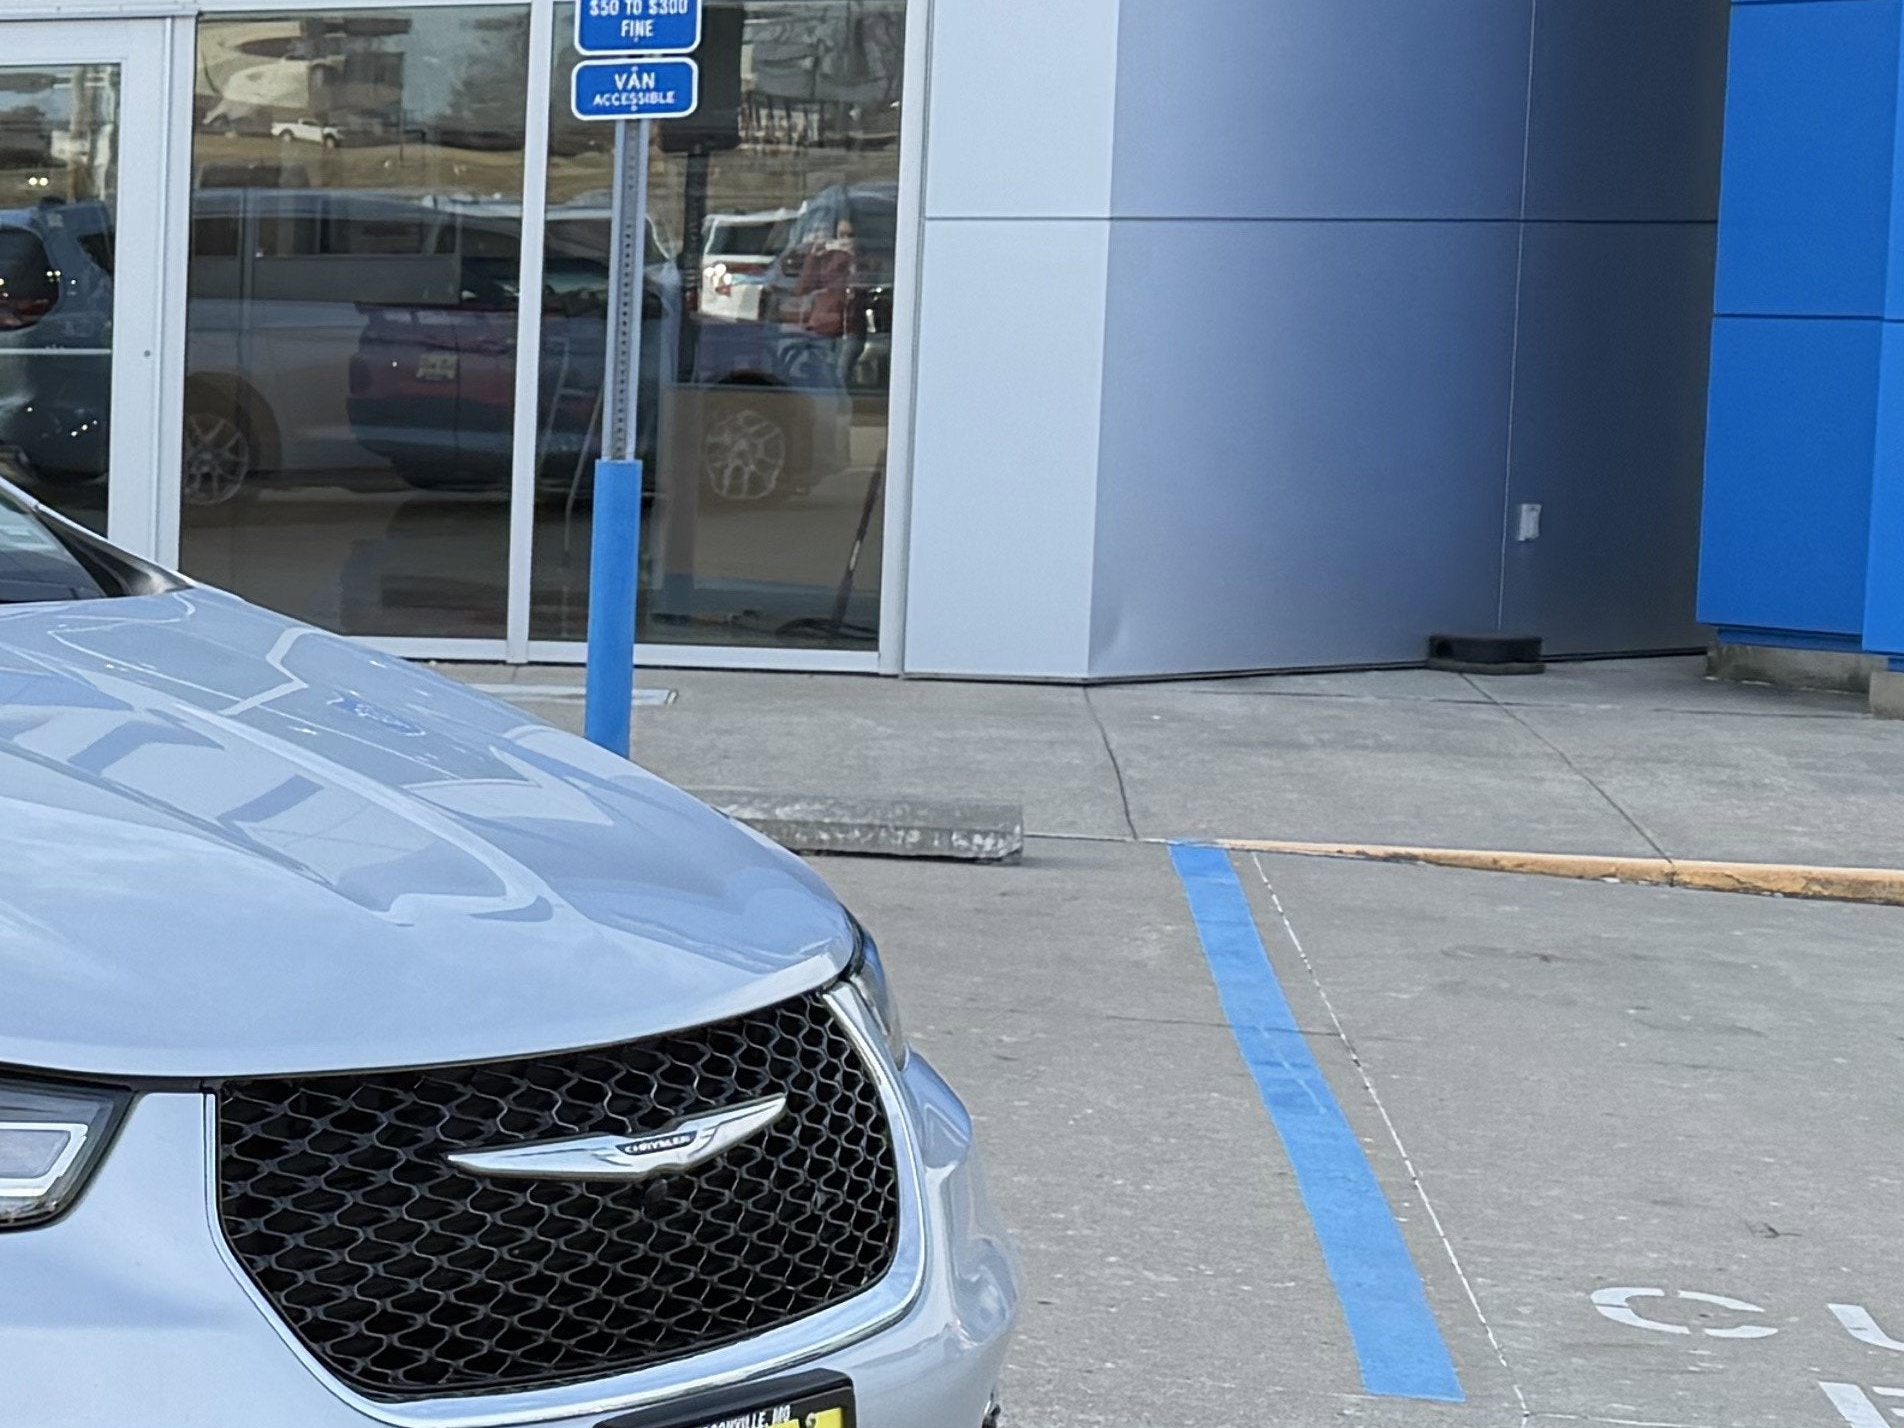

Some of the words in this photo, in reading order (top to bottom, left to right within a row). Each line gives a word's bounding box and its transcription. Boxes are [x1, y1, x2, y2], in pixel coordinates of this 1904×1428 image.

[621, 18, 655, 38] FINE
[614, 72, 655, 90] VAN
[593, 91, 675, 106] ACCESSIBLE
